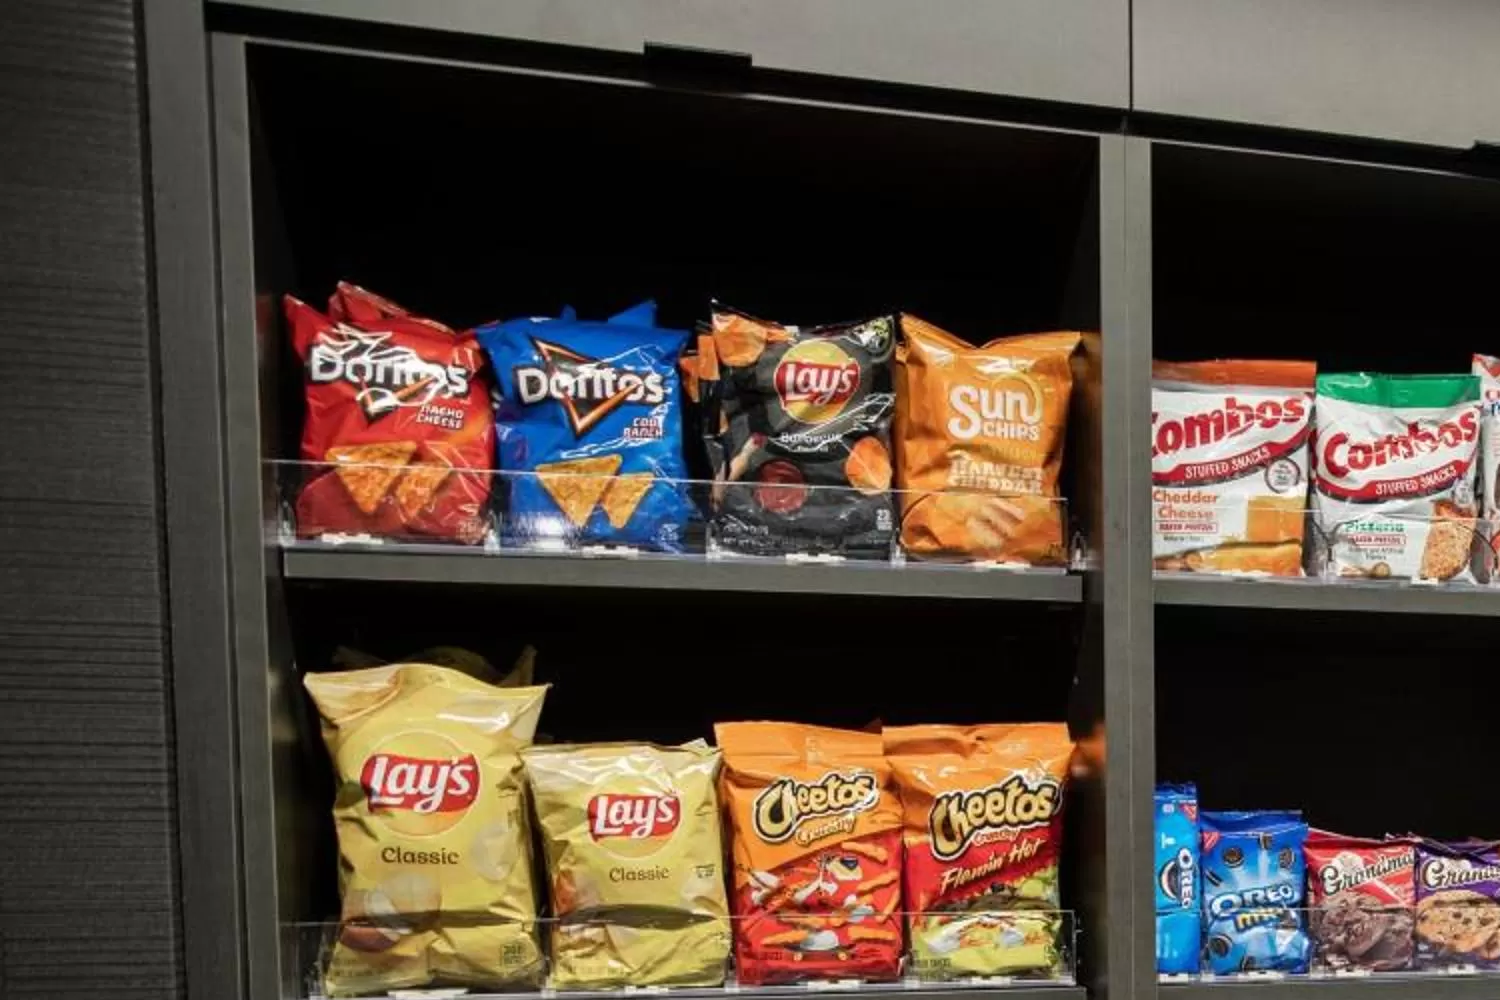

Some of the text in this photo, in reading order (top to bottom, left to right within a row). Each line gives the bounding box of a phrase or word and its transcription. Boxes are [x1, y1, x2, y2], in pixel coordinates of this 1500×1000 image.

[311, 343, 469, 397] Doritos
[516, 362, 664, 405] Doritos
[783, 362, 856, 405] Lay's
[947, 384, 1042, 439] Sun
[983, 420, 1040, 440] CHIPS
[1185, 446, 1270, 480] STUFFED SNACKS
[1323, 409, 1479, 478] Combos
[1152, 489, 1218, 504] Cheddar
[1375, 463, 1458, 497] STUFFED SNACKS
[368, 754, 474, 813] Lay's
[594, 793, 677, 839] Lay's
[756, 776, 876, 840] Cheetos
[930, 781, 1060, 858] Cheetos
[380, 846, 460, 867] Classic
[1008, 838, 1047, 863] Hot
[609, 864, 671, 882] Classic
[1177, 848, 1194, 909] OREO
[1211, 885, 1294, 918] OREO
